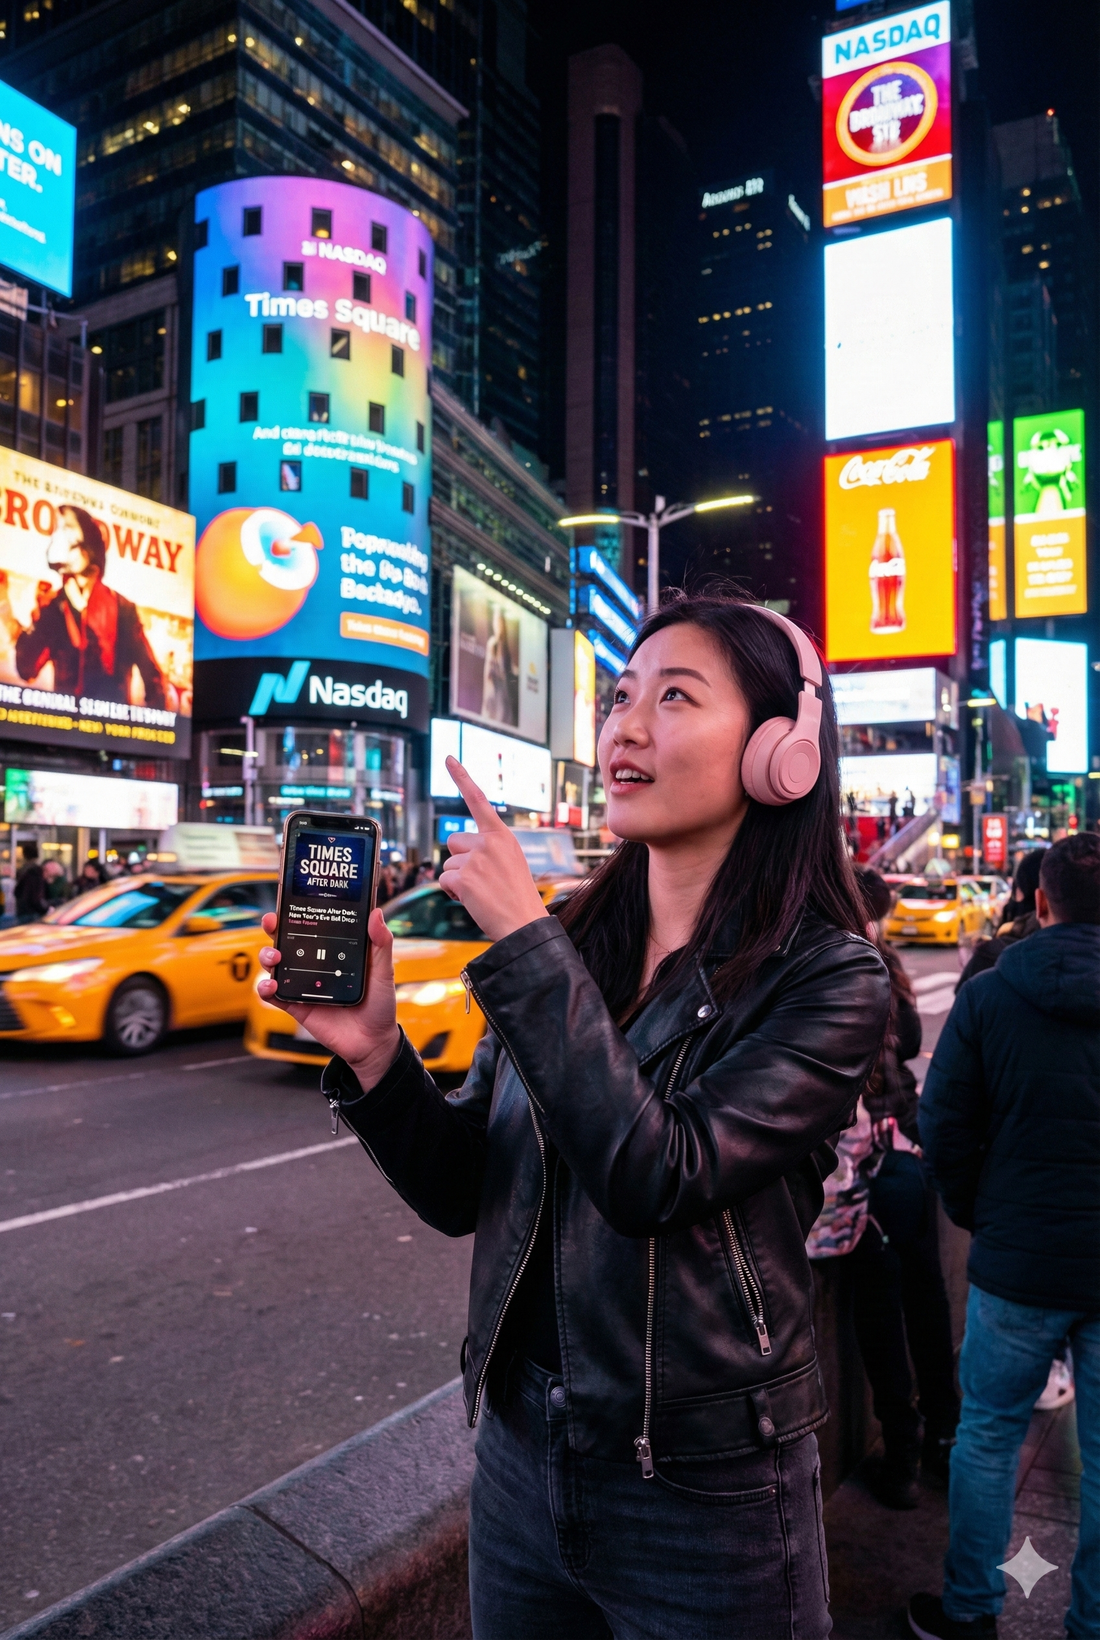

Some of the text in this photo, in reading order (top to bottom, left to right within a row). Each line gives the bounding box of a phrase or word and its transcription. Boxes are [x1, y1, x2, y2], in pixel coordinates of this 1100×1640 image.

[835, 13, 940, 64] NASDAQ
[28, 140, 62, 176] ON
[318, 242, 387, 276] NASDAQ
[244, 292, 421, 351] Times Square
[309, 675, 408, 719] Nasdaq
[299, 859, 359, 879] SQUARE
[308, 844, 353, 862] TIMES
[306, 877, 349, 889] AFTER DARK
